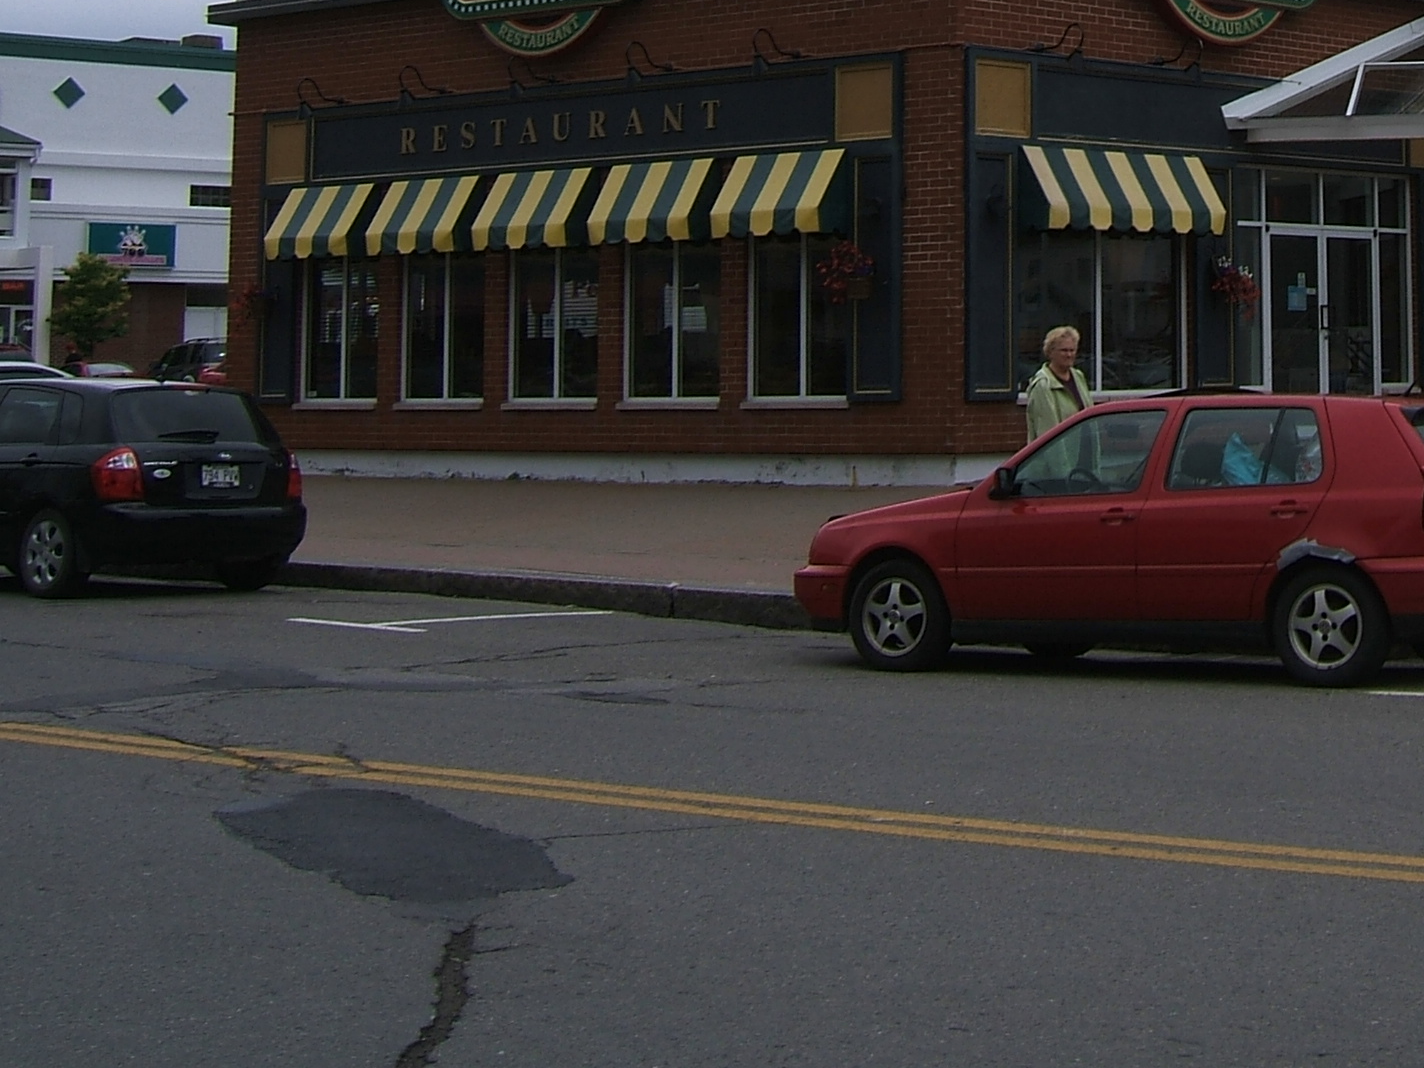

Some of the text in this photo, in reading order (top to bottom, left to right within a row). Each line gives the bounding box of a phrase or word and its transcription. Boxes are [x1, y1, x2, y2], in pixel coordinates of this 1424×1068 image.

[498, 14, 580, 49] RESTAURANT
[1185, 1, 1266, 36] RESTAURANT
[399, 99, 721, 155] RESTAURANT
